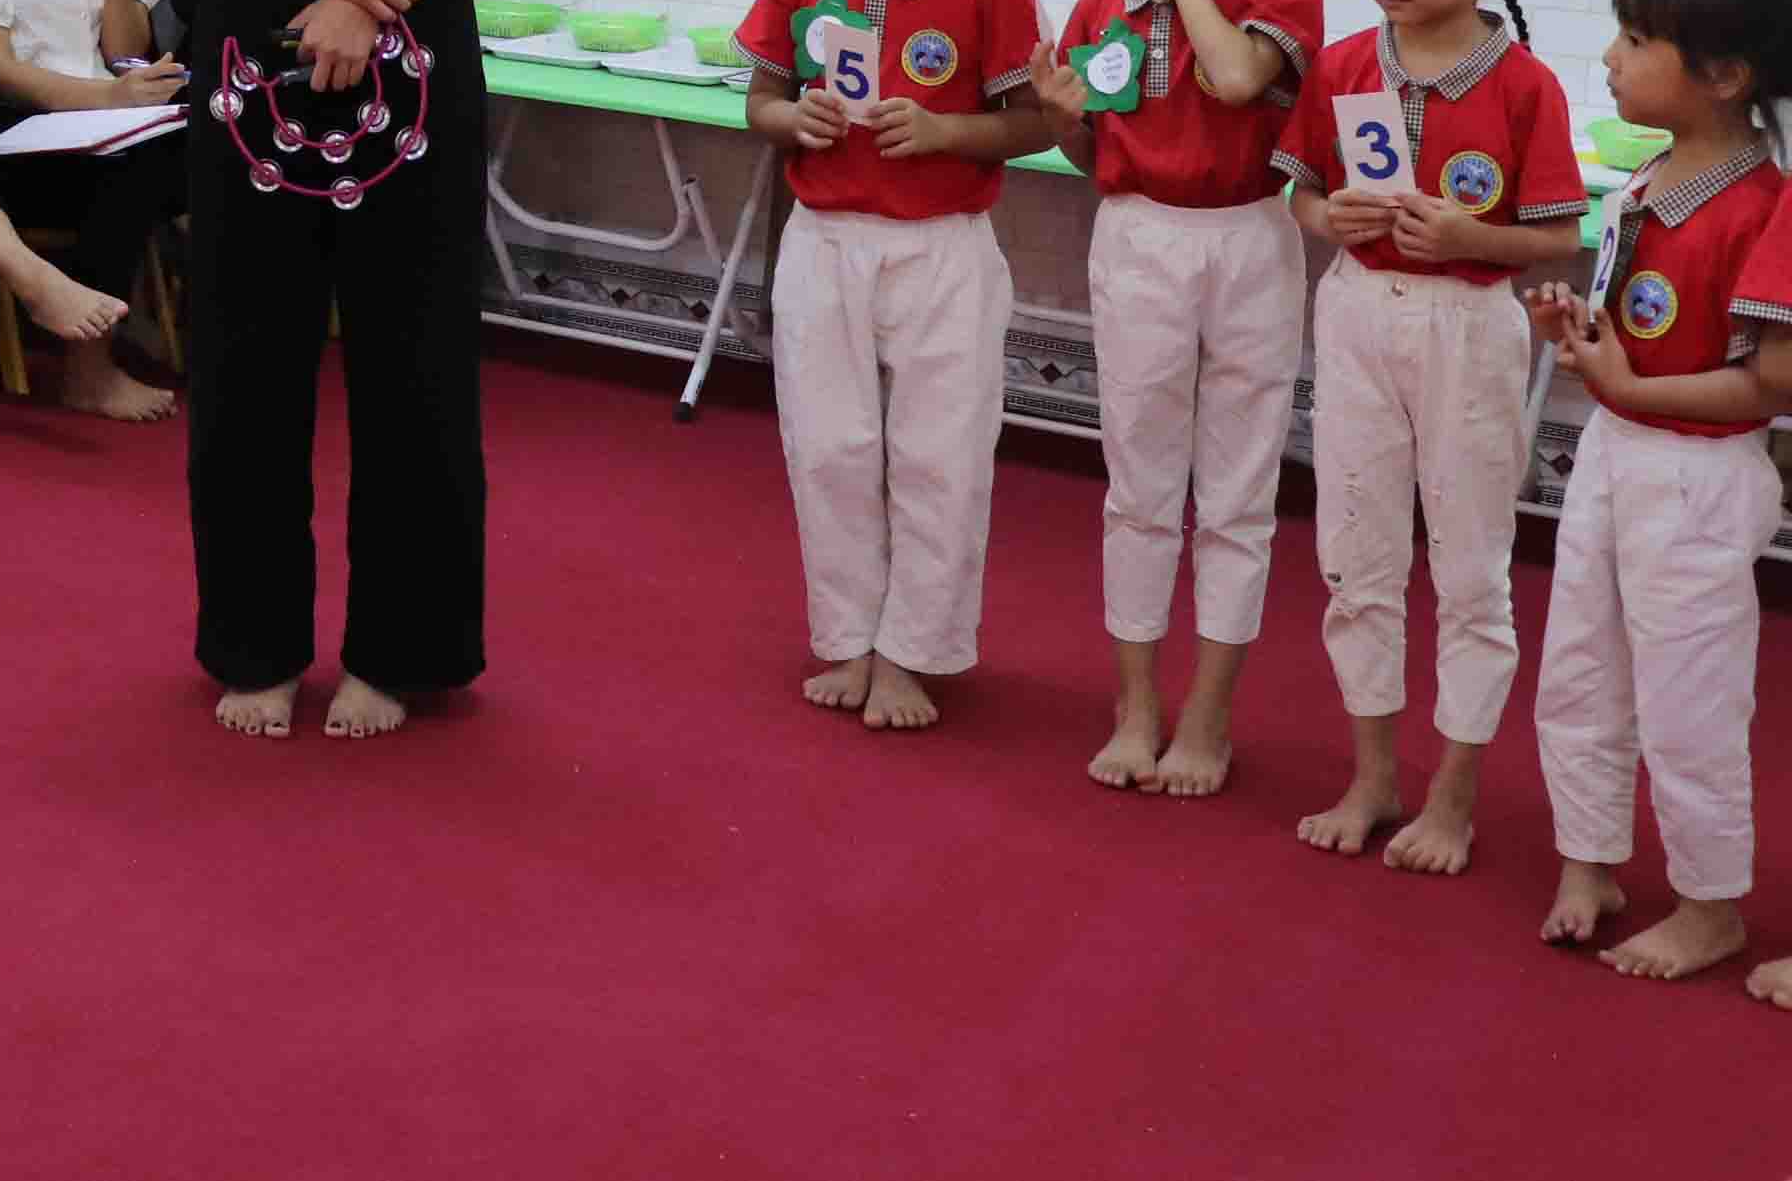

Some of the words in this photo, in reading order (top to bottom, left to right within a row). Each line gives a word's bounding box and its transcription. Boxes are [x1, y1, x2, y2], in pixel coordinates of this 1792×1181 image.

[833, 49, 870, 100] 5
[1355, 121, 1400, 180] 3
[1594, 225, 1615, 292] 2
